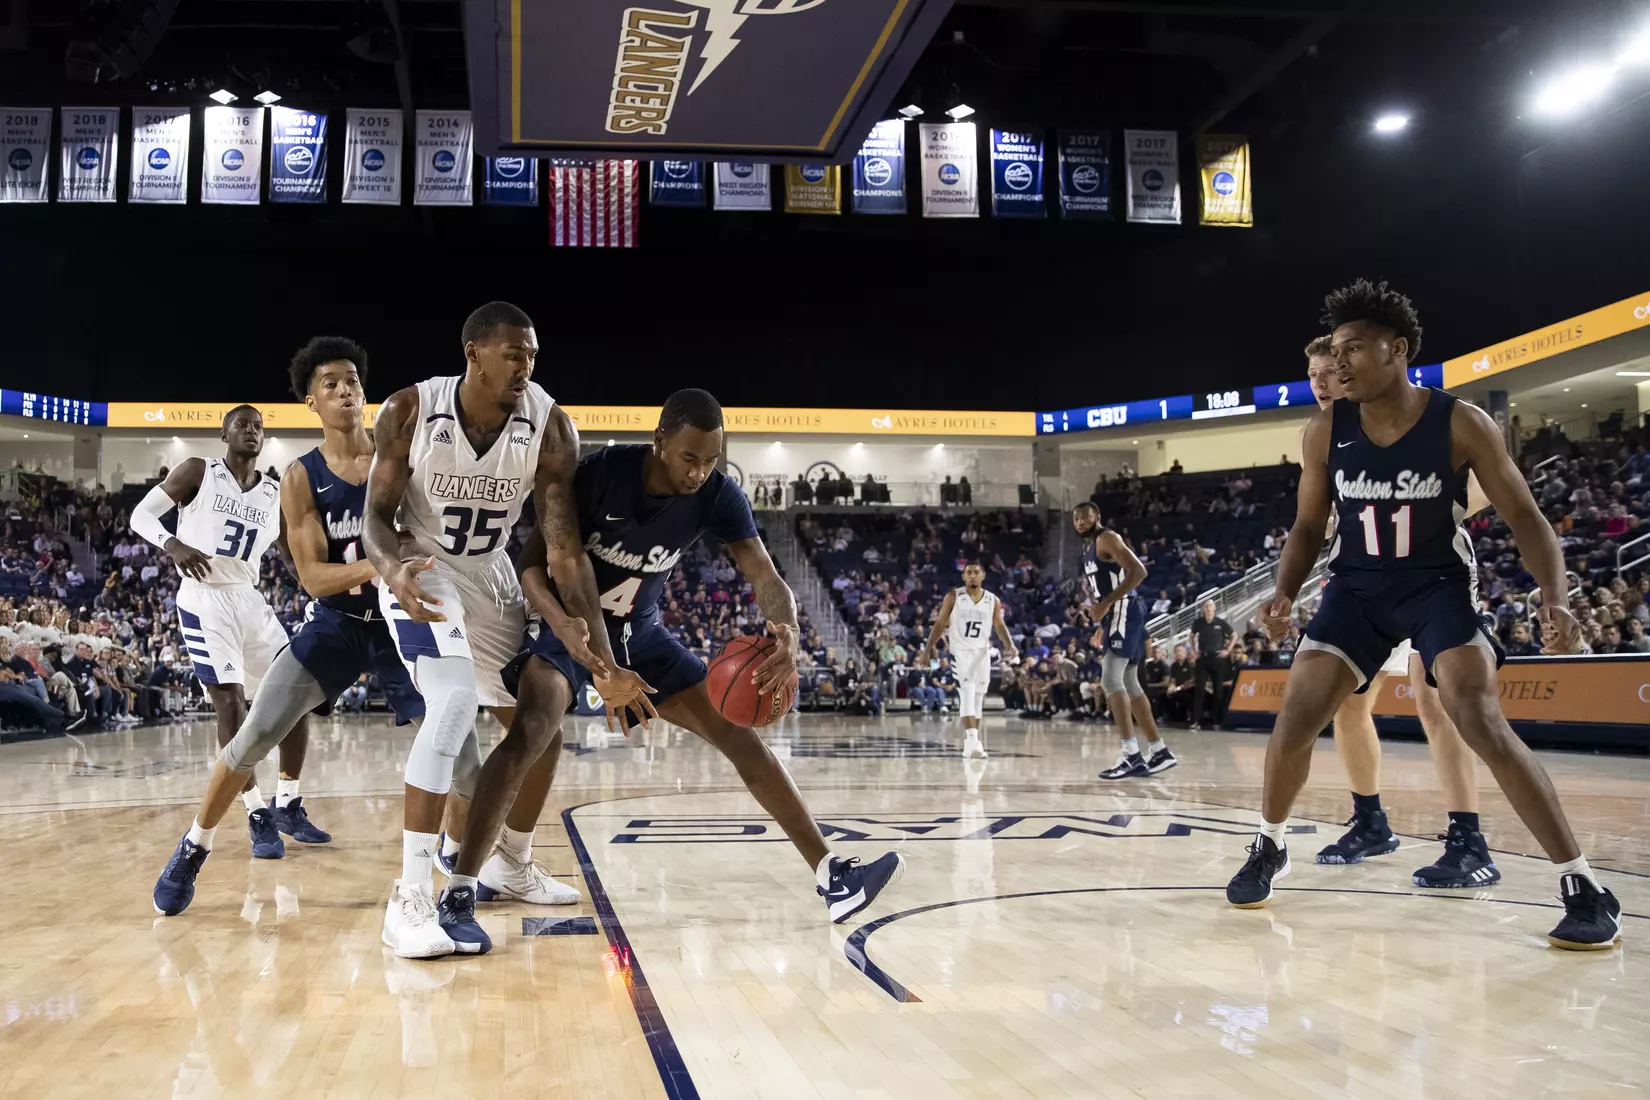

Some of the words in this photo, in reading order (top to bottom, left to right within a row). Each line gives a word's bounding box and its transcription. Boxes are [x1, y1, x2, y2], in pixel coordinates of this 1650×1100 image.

[605, 7, 699, 135] LANCERS
[6, 115, 39, 126] 2018
[73, 115, 106, 125] 2018
[144, 115, 176, 125] 2017
[358, 116, 390, 127] 2015
[427, 118, 459, 128] 2014
[285, 128, 312, 136] MEN'S
[931, 132, 958, 142] 201
[0, 137, 47, 145] ASKETBALL
[1001, 132, 1033, 143] 2017
[1069, 136, 1099, 146] 2017
[996, 144, 1037, 152] WOMEN'S
[1136, 138, 1166, 148] 2017
[992, 153, 1043, 161] BASKETBALL
[802, 169, 824, 177] NCAA
[205, 182, 257, 190] TOURNAMENT
[352, 184, 381, 192] SWEET
[484, 181, 535, 189] CHAMPIONS
[653, 181, 704, 190] CHAMPIONS
[853, 189, 903, 197] CHAMPIONS
[994, 193, 1043, 201] CHAMPIONS
[1491, 343, 1527, 366] AYRES
[1532, 324, 1583, 353] HOTELS
[1087, 406, 1127, 428] CBU
[1159, 400, 1168, 419] 1
[1278, 385, 1289, 406] 2
[23, 409, 33, 417] FLS
[74, 408, 78, 416] 2
[168, 411, 212, 421] AYRES
[585, 413, 642, 424] HOTELS
[724, 415, 760, 426] YRES
[766, 416, 821, 426] HOTELS
[895, 417, 937, 428] AYRES
[943, 418, 997, 429] HOTELS
[433, 437, 453, 445] adidas
[510, 436, 530, 446] WAC
[430, 473, 520, 503] LANCERS
[1335, 469, 1393, 502] Jackson
[1394, 470, 1442, 500] State
[213, 494, 270, 528] LANCERS
[326, 509, 362, 539] Jacks
[442, 506, 508, 556] 35
[1358, 504, 1412, 558] 11
[215, 520, 258, 562] 31
[584, 531, 643, 570] Jackson
[642, 545, 681, 573] Stat
[600, 576, 642, 617] 4
[964, 621, 982, 638] 15
[1257, 682, 1285, 697] AYRE
[1498, 680, 1557, 700] OTELS
